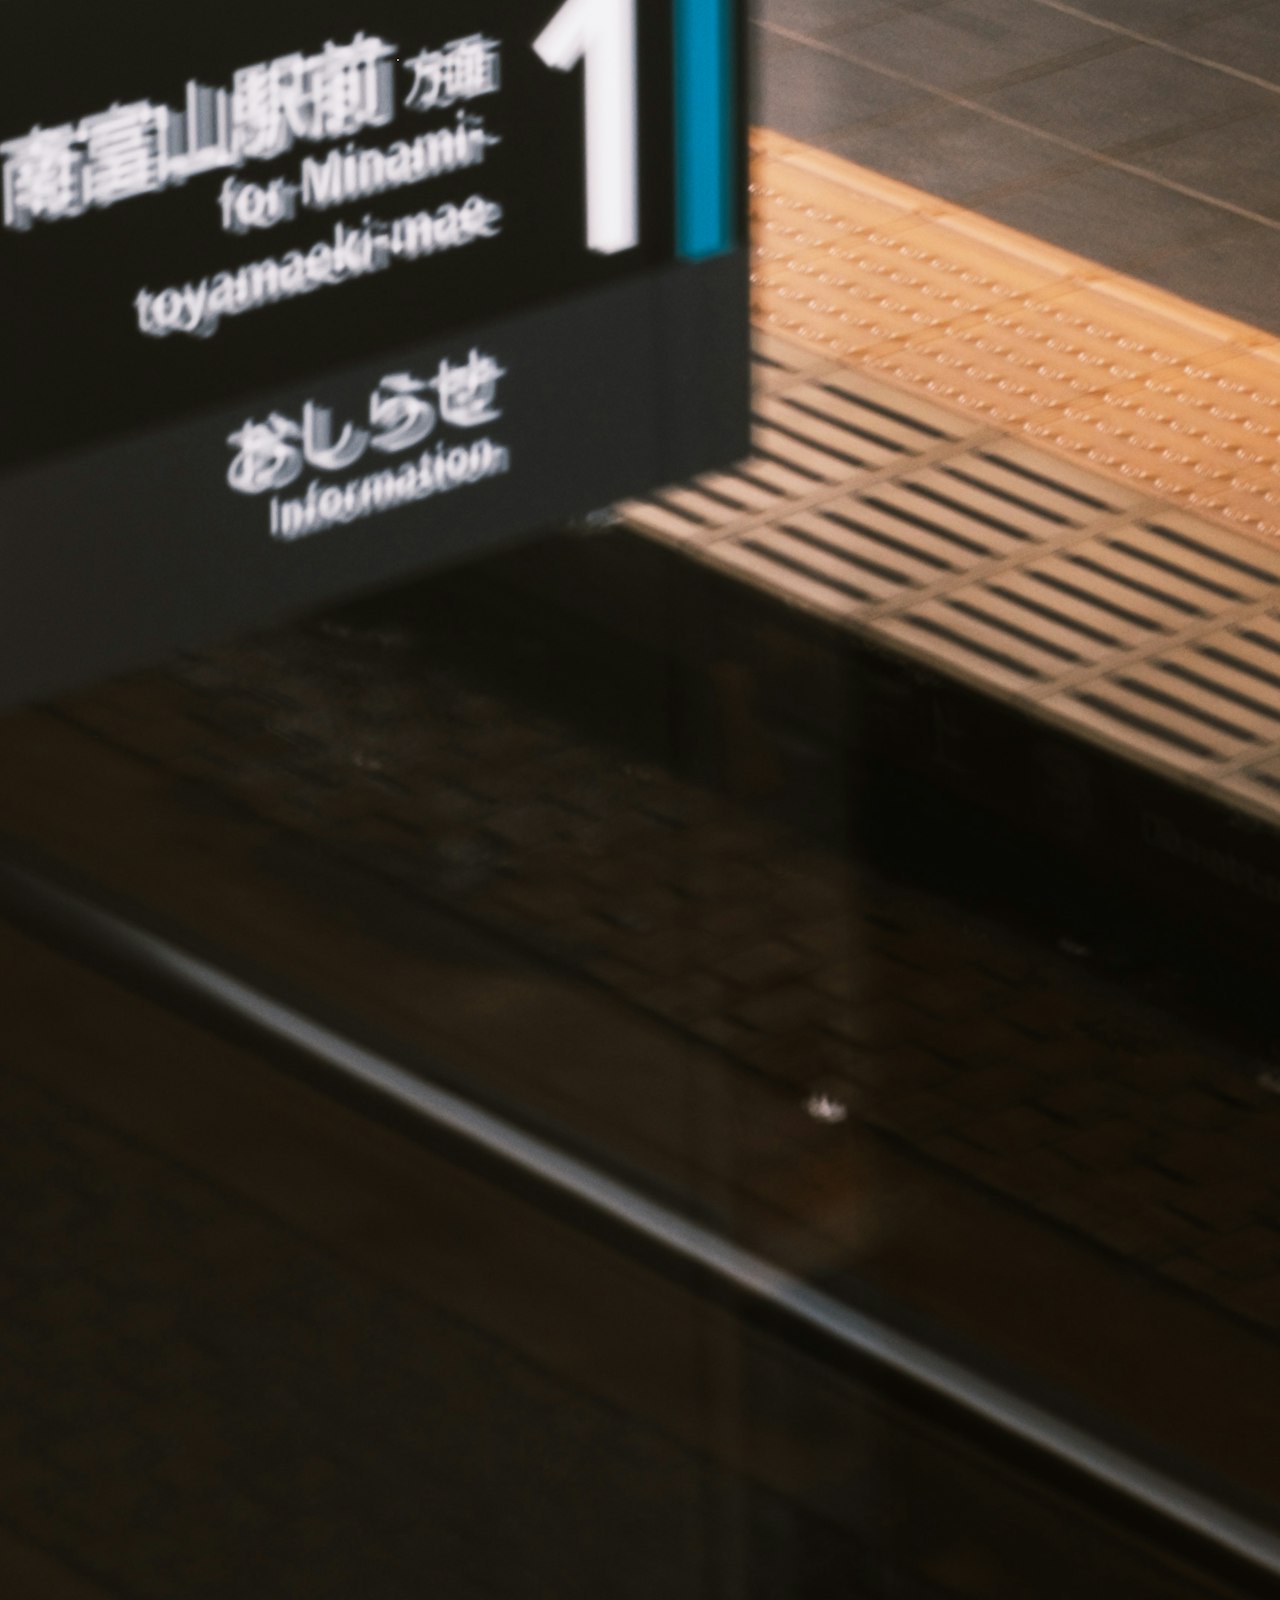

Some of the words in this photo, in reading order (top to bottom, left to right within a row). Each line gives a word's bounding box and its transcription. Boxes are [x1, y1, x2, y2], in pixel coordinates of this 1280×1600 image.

[134, 194, 502, 338] toyamaeki-mae
[217, 174, 299, 235] for
[226, 346, 506, 495] おしらせ
[269, 437, 510, 542] Information
